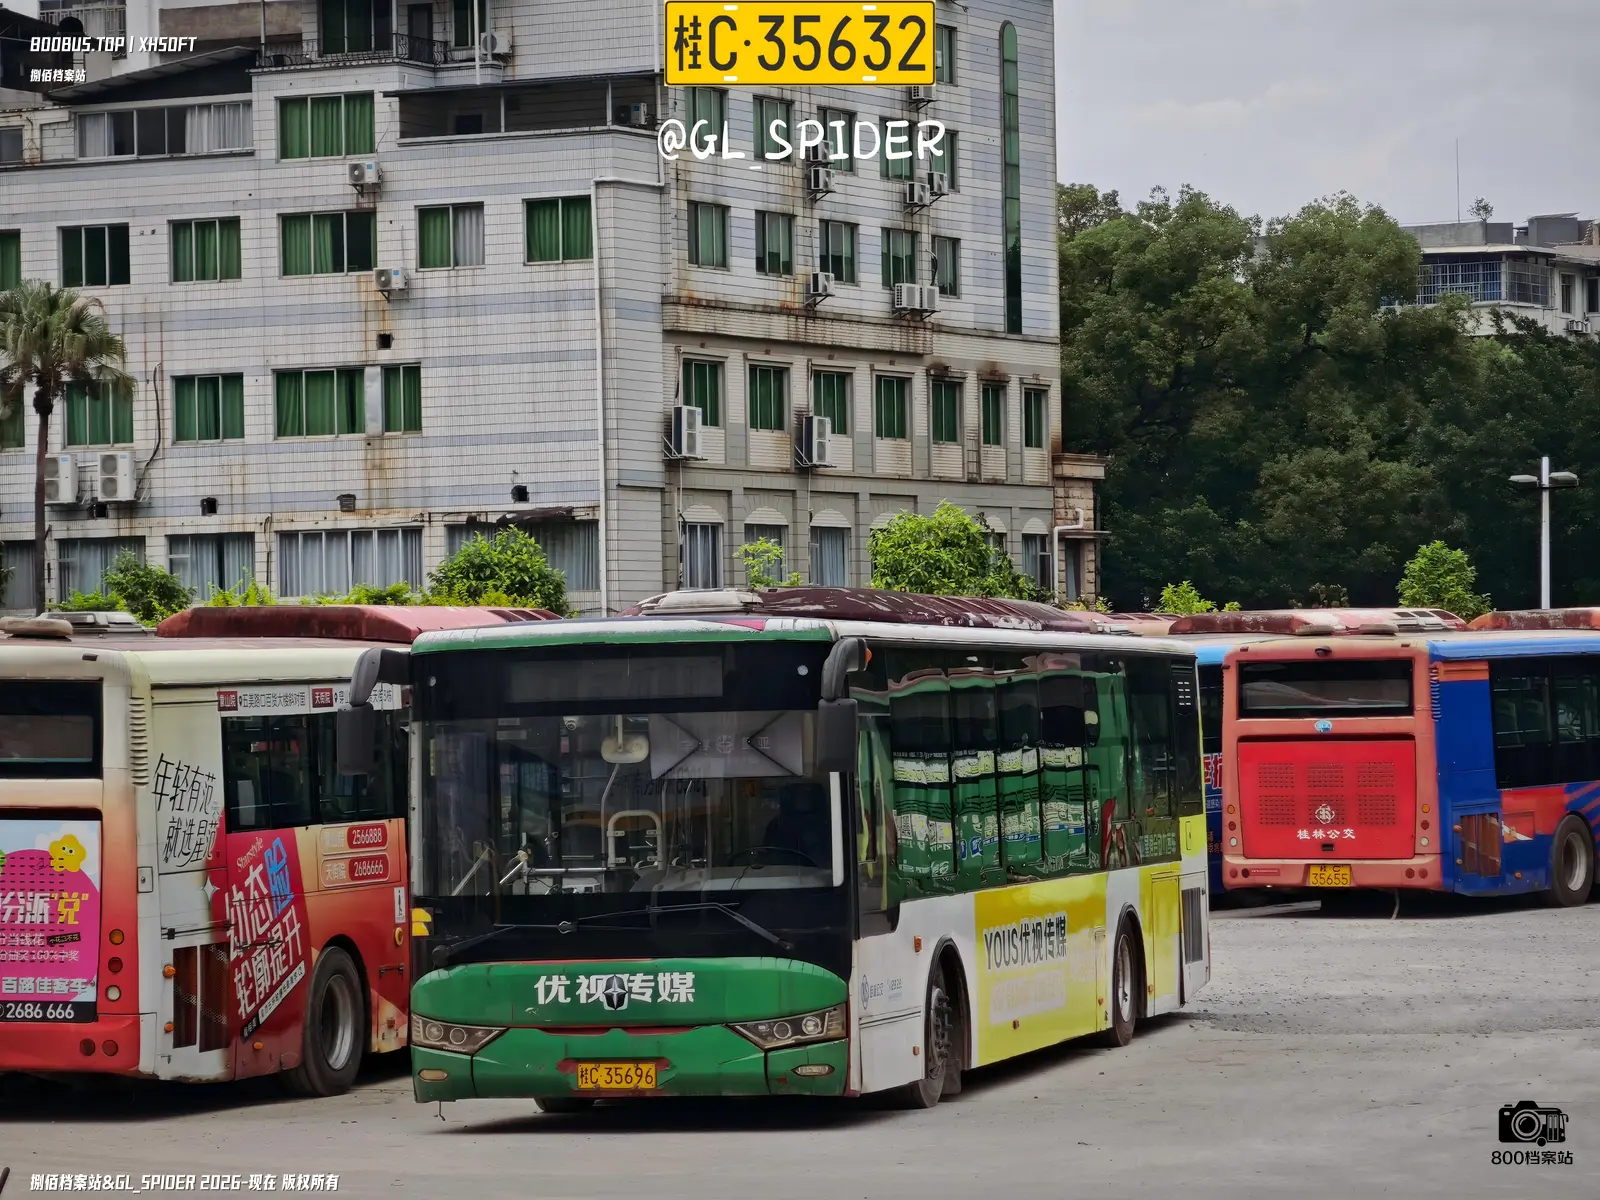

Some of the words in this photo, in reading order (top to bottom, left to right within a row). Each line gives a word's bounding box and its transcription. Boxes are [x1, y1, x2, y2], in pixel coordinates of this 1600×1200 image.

[352, 827, 383, 845] 2566888
[1296, 828, 1356, 840] 桂林公交
[354, 860, 384, 877] 2686666
[1311, 873, 1349, 886] 35655
[534, 971, 695, 1005] 优视传媒
[6, 1003, 43, 1019] 2686
[46, 1003, 75, 1020] 666
